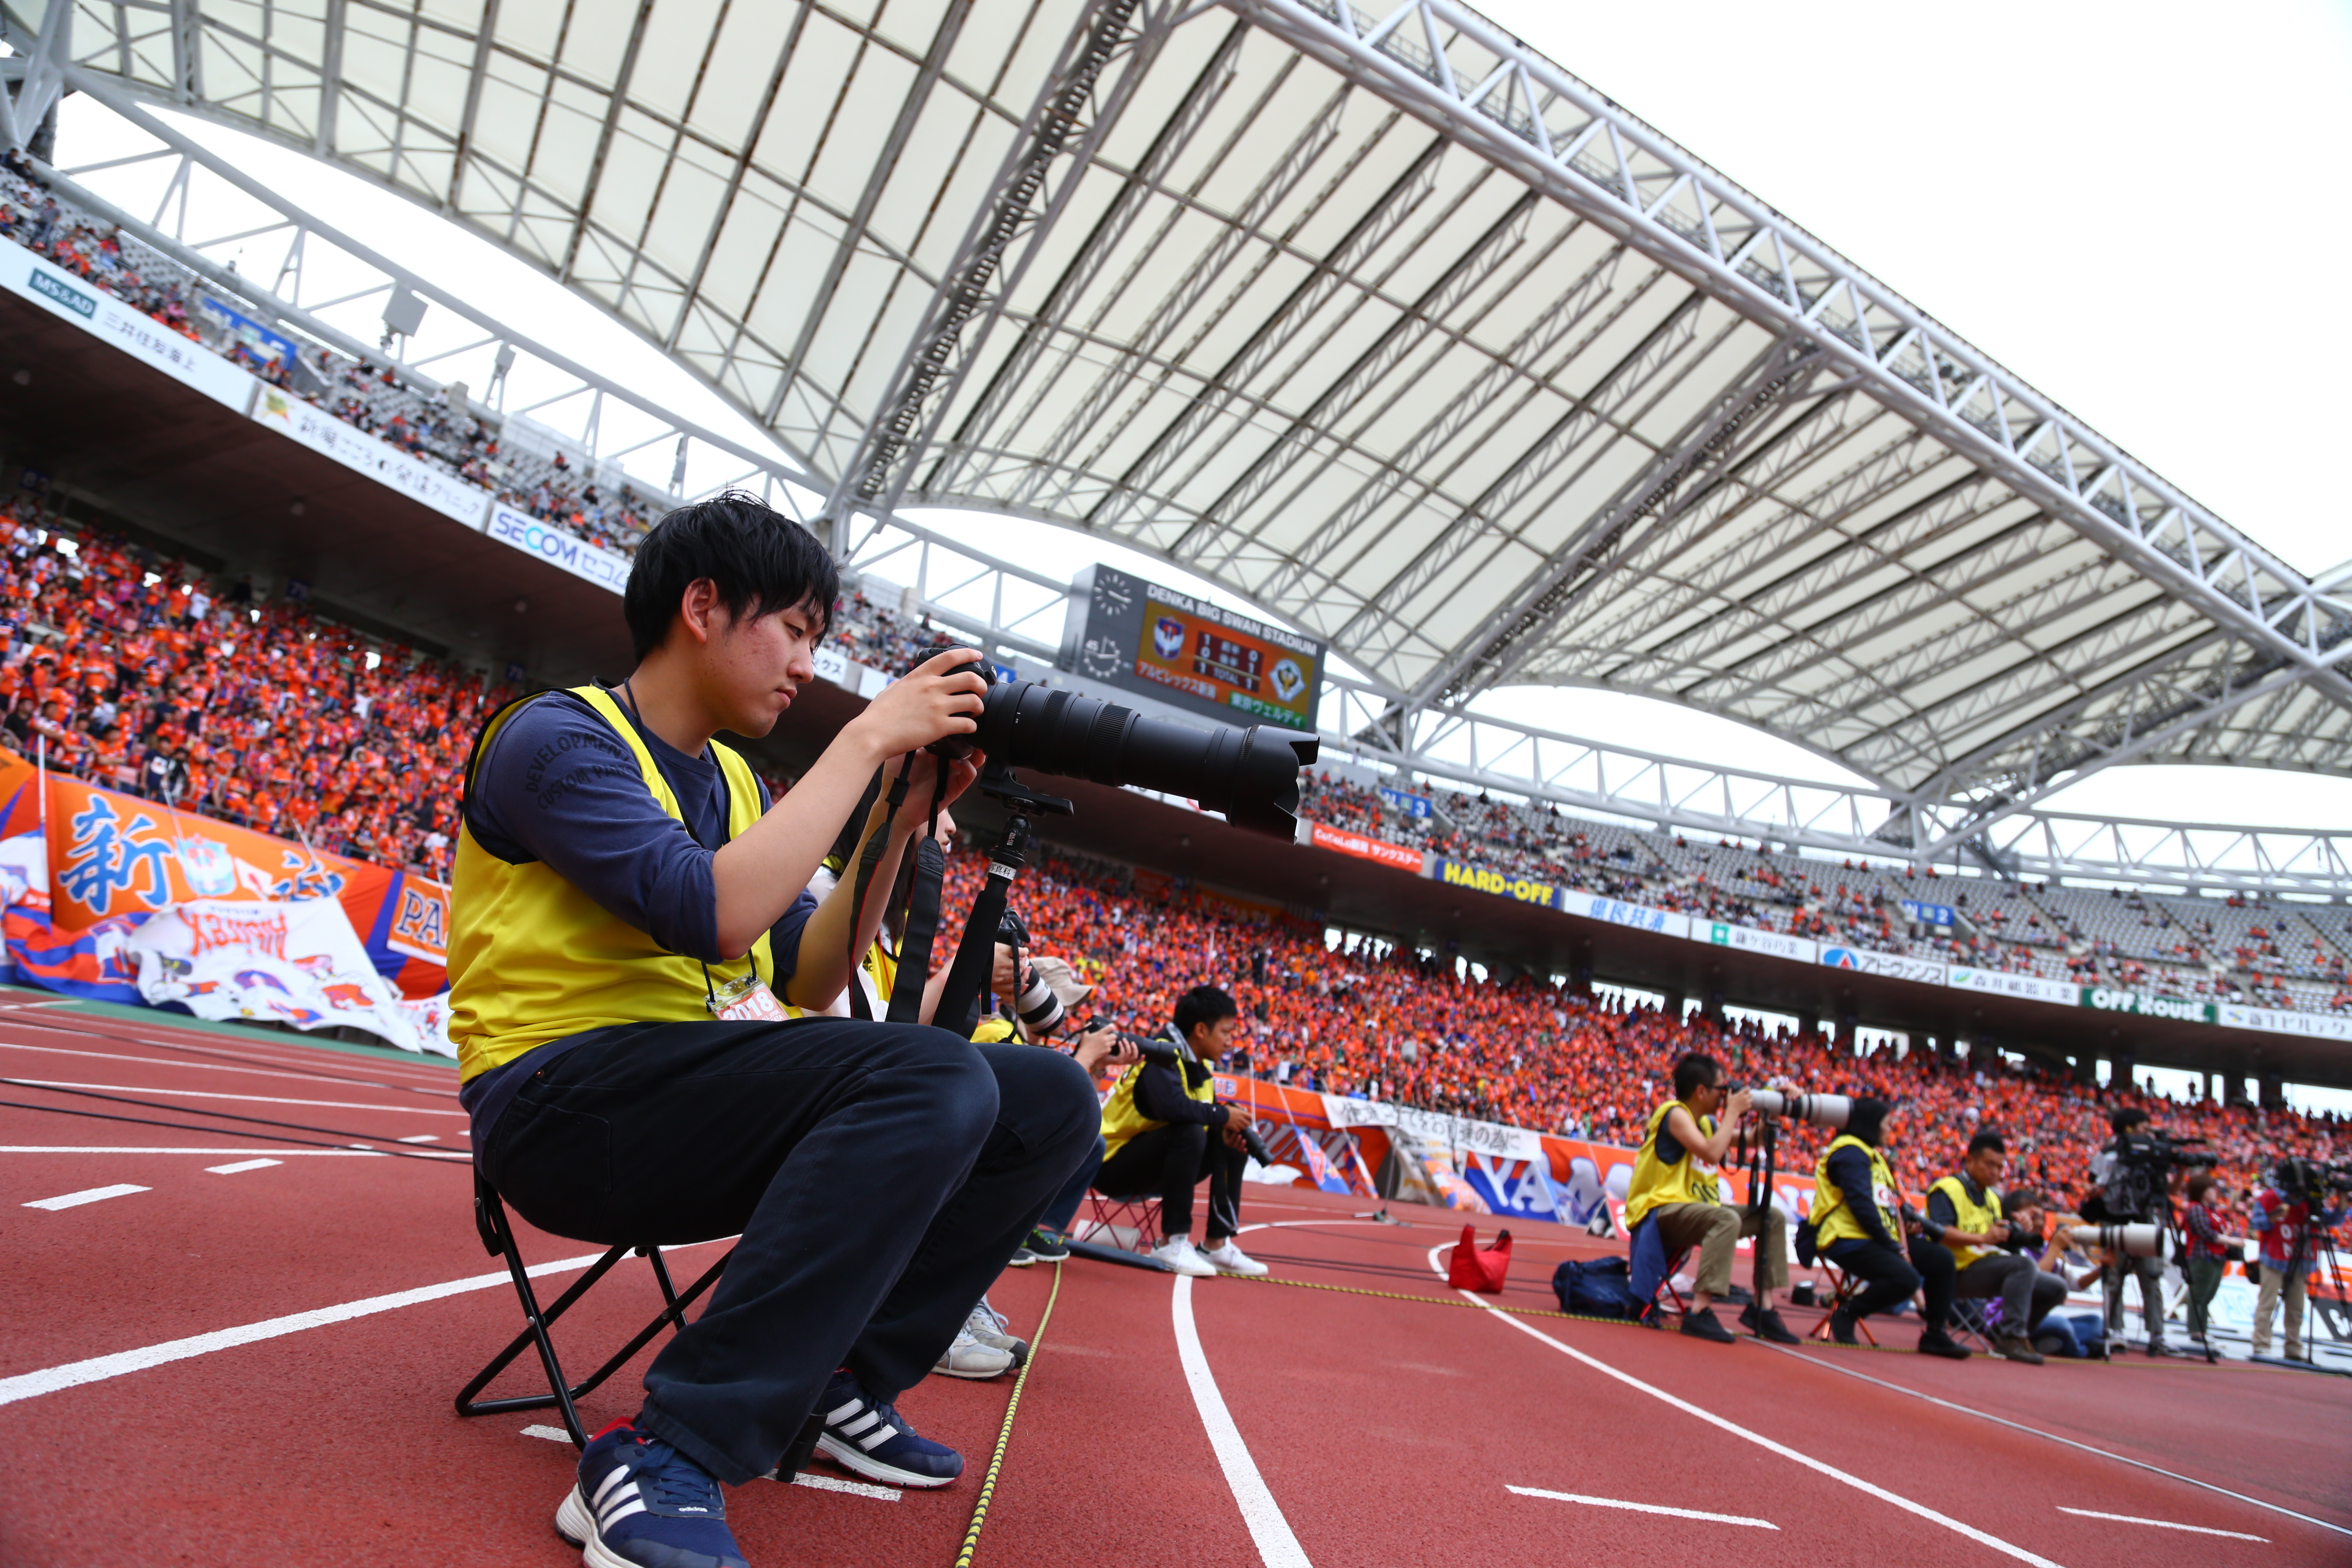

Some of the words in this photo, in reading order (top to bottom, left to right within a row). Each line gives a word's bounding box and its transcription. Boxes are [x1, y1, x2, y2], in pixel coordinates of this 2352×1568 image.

[33, 271, 94, 315] MS&AD
[495, 512, 578, 567] SECOM
[1147, 583, 1194, 612] DENKA
[1196, 601, 1221, 622] BIG
[1222, 609, 1262, 637] SWAN
[1263, 626, 1317, 656] STADIUM
[536, 768, 591, 811] CUSTOM
[58, 793, 174, 916] 新
[393, 886, 449, 948] PA
[1589, 898, 1667, 933] 県民共済
[1937, 910, 1948, 925] 2
[723, 992, 774, 1020] 2018
[2090, 988, 2136, 1013] OFF
[2137, 996, 2208, 1023] HOUSE
[1213, 1078, 1237, 1096] UE
